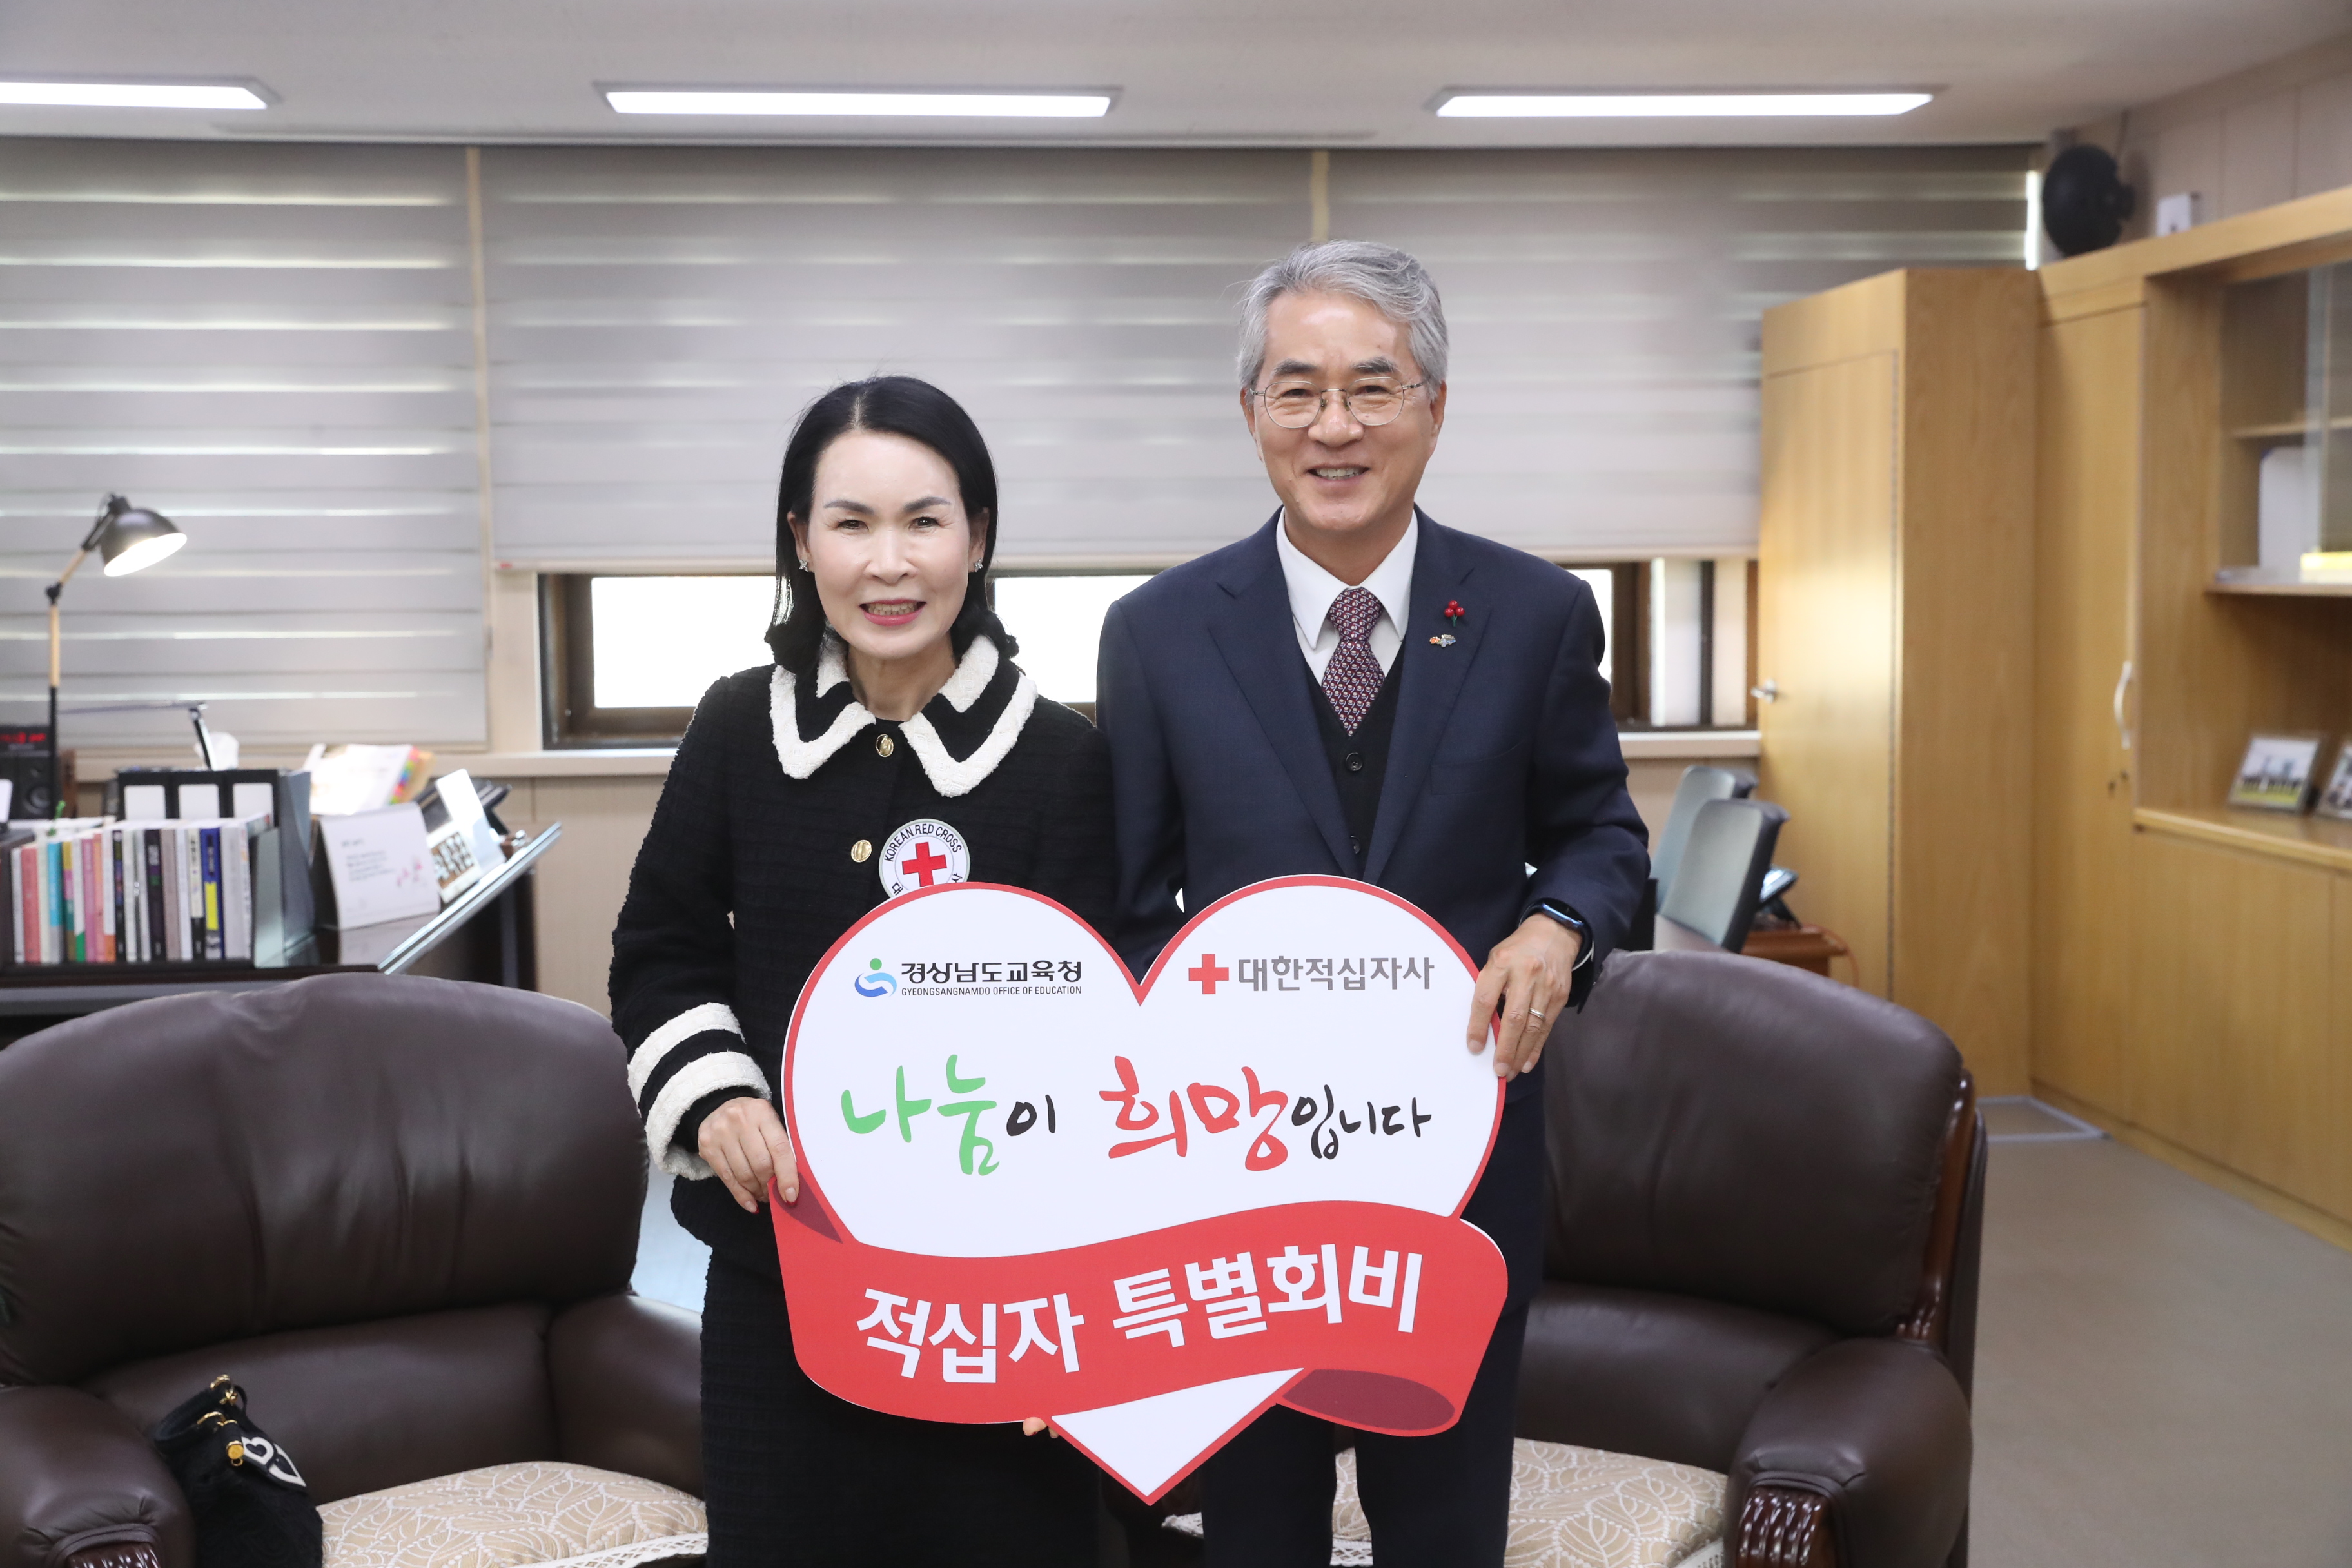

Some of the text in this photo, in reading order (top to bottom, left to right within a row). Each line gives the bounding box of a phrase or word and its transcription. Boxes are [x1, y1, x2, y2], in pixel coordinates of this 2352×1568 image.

[884, 823, 962, 862] KOREAN RED CROSS
[901, 960, 1081, 984] 경상남도교육청
[1238, 956, 1435, 992] 대한적십자사
[901, 986, 1082, 996] GYEONGSANGNAMDO OFFICE OF EDUCATION
[841, 1054, 1432, 1176] 나눔이 희망입니다
[856, 1243, 1423, 1384] 적십자 특별회비
